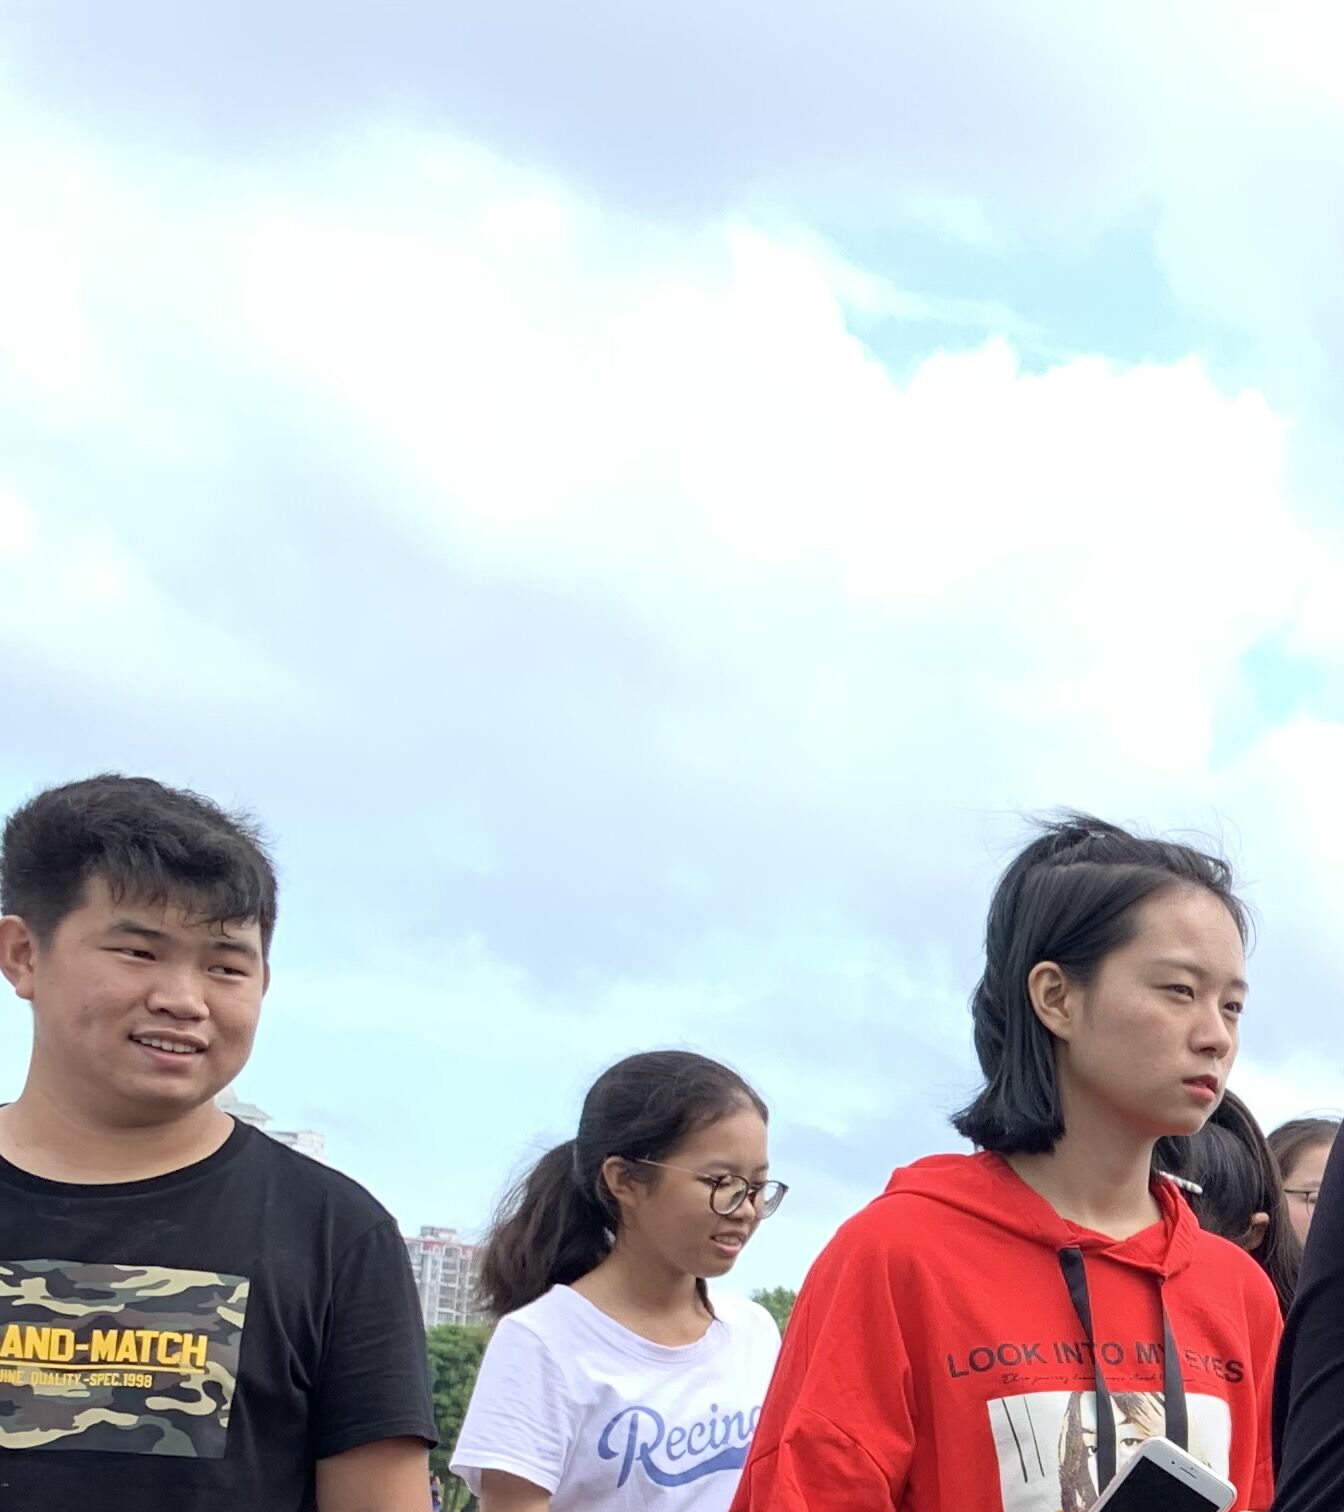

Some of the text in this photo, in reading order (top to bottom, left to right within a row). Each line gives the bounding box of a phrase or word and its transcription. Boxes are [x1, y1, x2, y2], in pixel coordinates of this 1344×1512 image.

[0, 1324, 208, 1367] AND-MATCH
[946, 1343, 1047, 1378] LOOK
[1053, 1340, 1124, 1366] INTO
[1184, 1348, 1245, 1384] EYES
